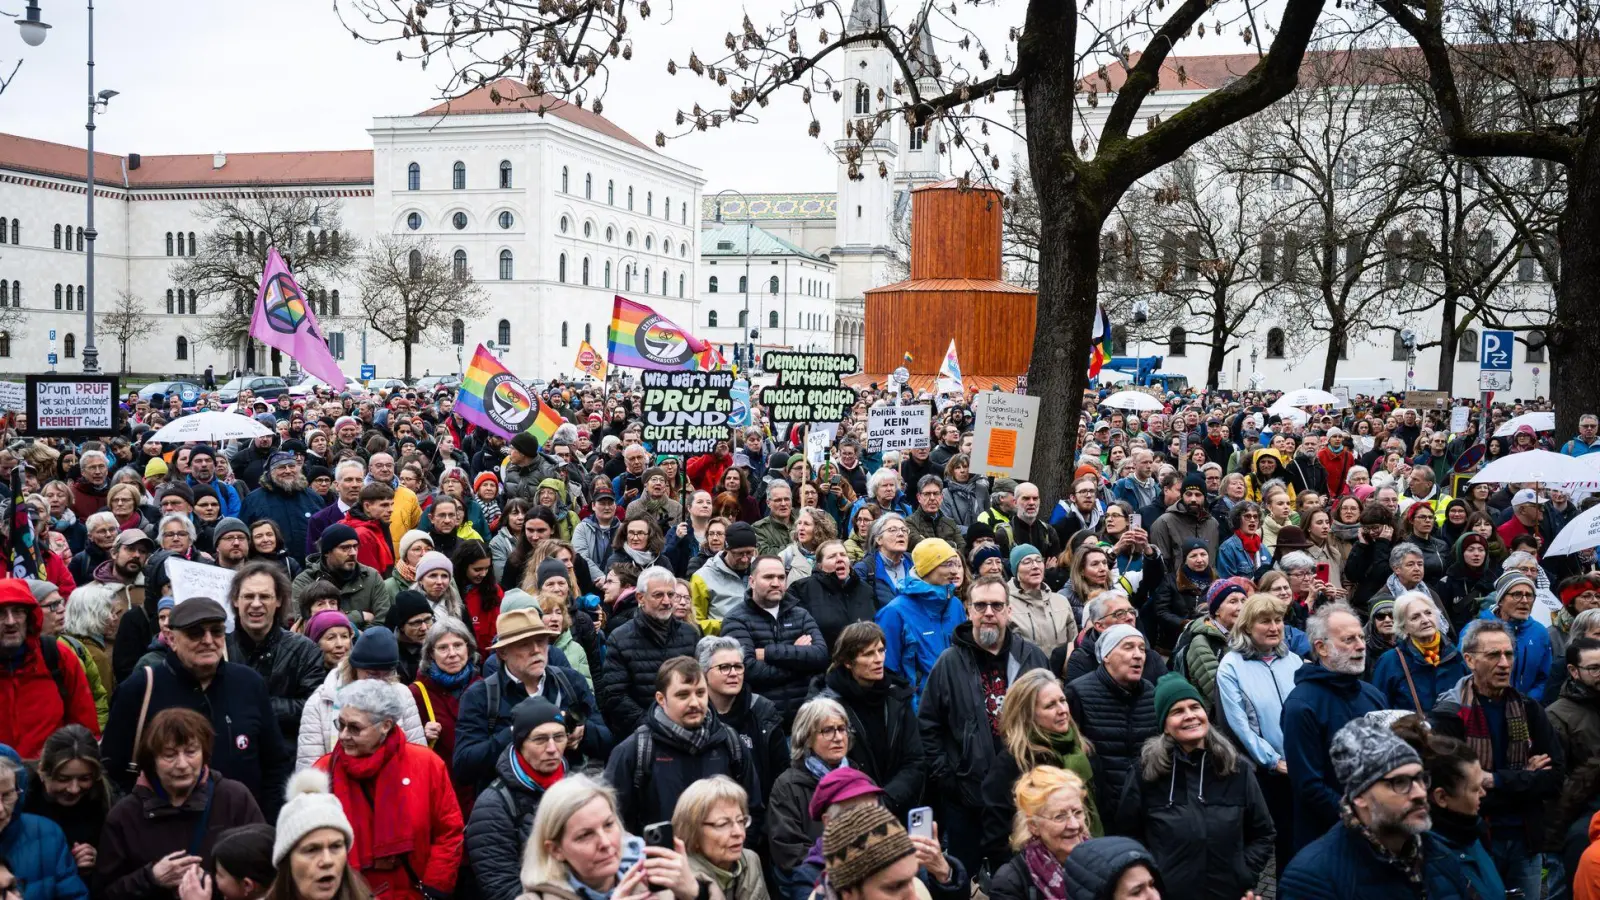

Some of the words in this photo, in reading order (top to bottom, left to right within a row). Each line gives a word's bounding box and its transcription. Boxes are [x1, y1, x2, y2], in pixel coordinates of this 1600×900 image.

[1484, 334, 1501, 364] P
[766, 354, 855, 371] Demokratische
[644, 372, 669, 387] Wie
[671, 372, 706, 388] wär's
[709, 374, 733, 388] mit
[781, 369, 839, 387] Parteien,
[38, 383, 71, 395] D'rum
[75, 383, 109, 395] PRÜF
[763, 389, 805, 404] macht
[807, 388, 855, 405] endlich
[53, 396, 65, 405] sich
[644, 387, 731, 412] PRÜFen
[986, 393, 1007, 405] Take
[42, 407, 54, 415] ob
[55, 406, 71, 415] sich
[89, 406, 106, 415] noch
[774, 404, 811, 420] euren
[813, 404, 844, 420] Job!
[871, 408, 897, 417] Politik
[986, 405, 1029, 418] responsibility
[39, 416, 83, 426] FREIHEIT
[84, 416, 108, 426] findet
[647, 411, 727, 426] UND
[883, 417, 909, 427] KEIN
[643, 425, 684, 440] GUTE
[687, 425, 729, 440] Politik
[869, 428, 895, 437] GLÜCK
[901, 427, 924, 436] SPIEL
[656, 438, 717, 453] machen?
